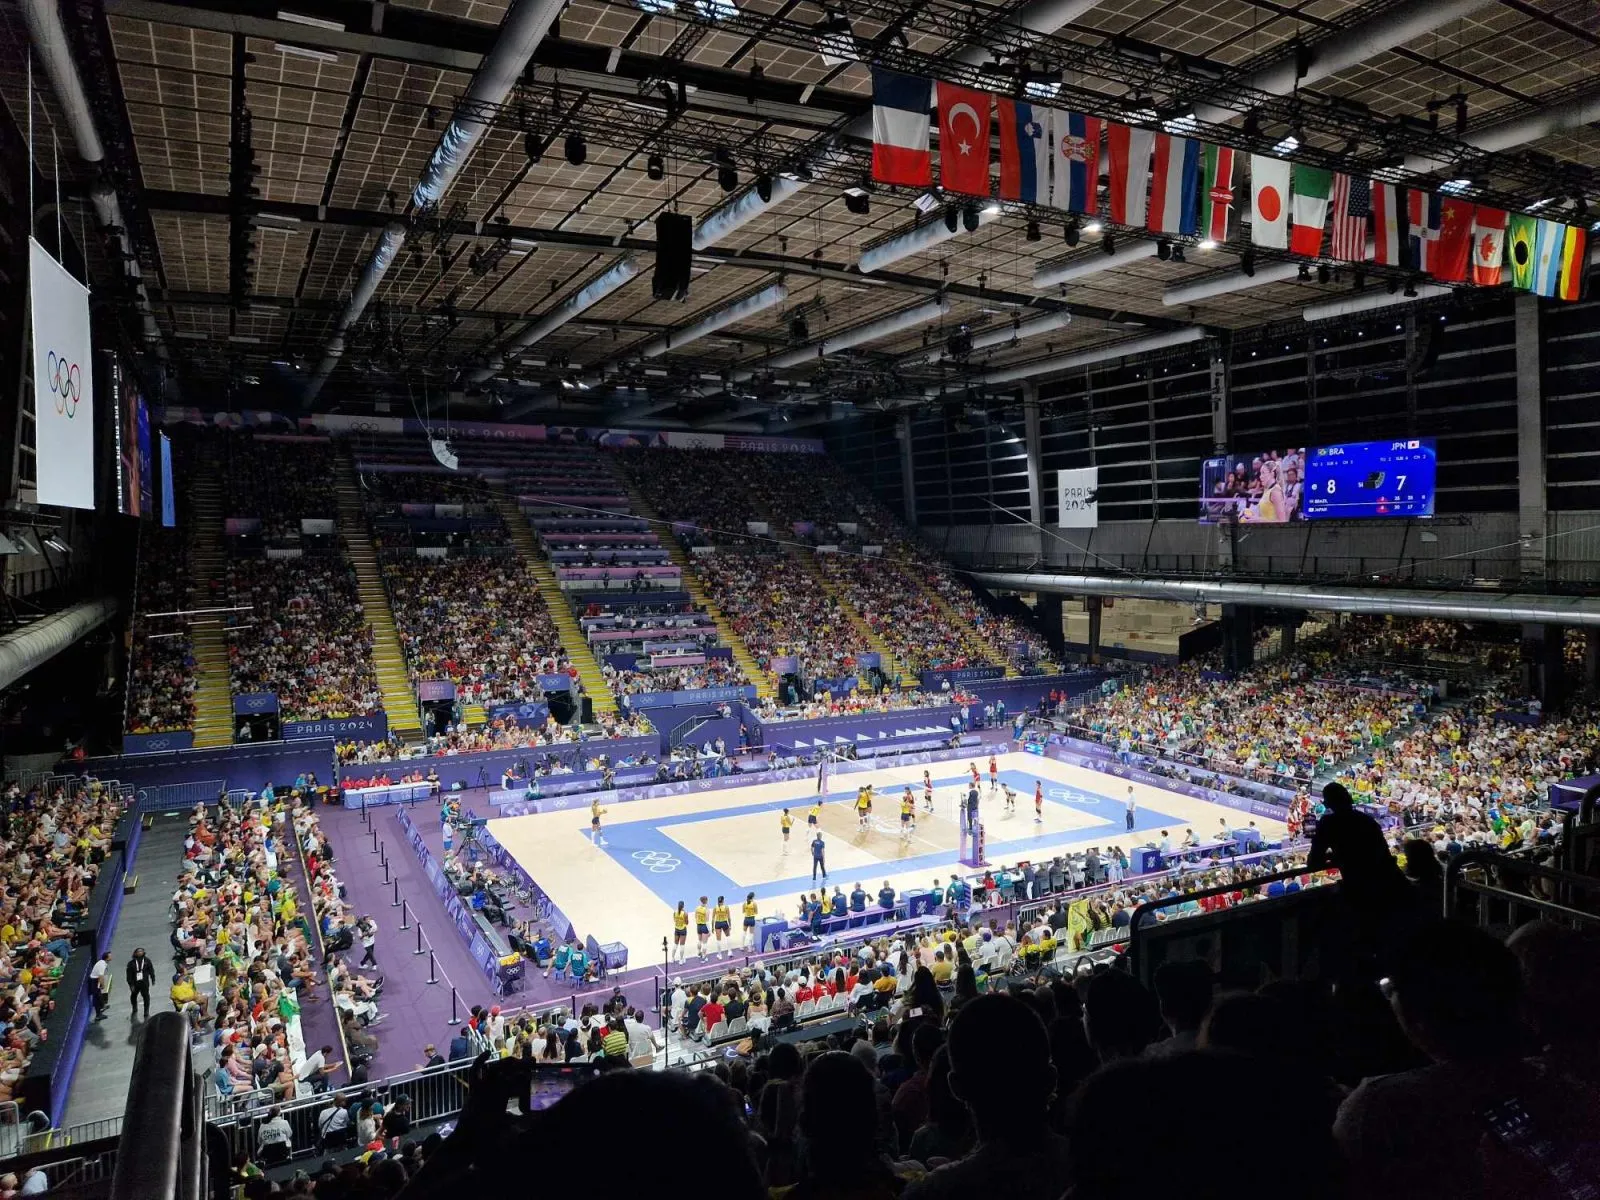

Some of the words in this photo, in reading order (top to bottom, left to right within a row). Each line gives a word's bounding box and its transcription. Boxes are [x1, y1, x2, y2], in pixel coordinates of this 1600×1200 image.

[741, 441, 778, 452] PARIS
[1328, 448, 1345, 456] BRA
[1391, 442, 1406, 451] JPN
[1327, 479, 1336, 494] 8
[1396, 475, 1407, 491] 7
[1064, 487, 1094, 498] PARIS
[689, 691, 717, 700] PARIS
[297, 723, 335, 734] PARIS
[339, 720, 373, 731] 2024
